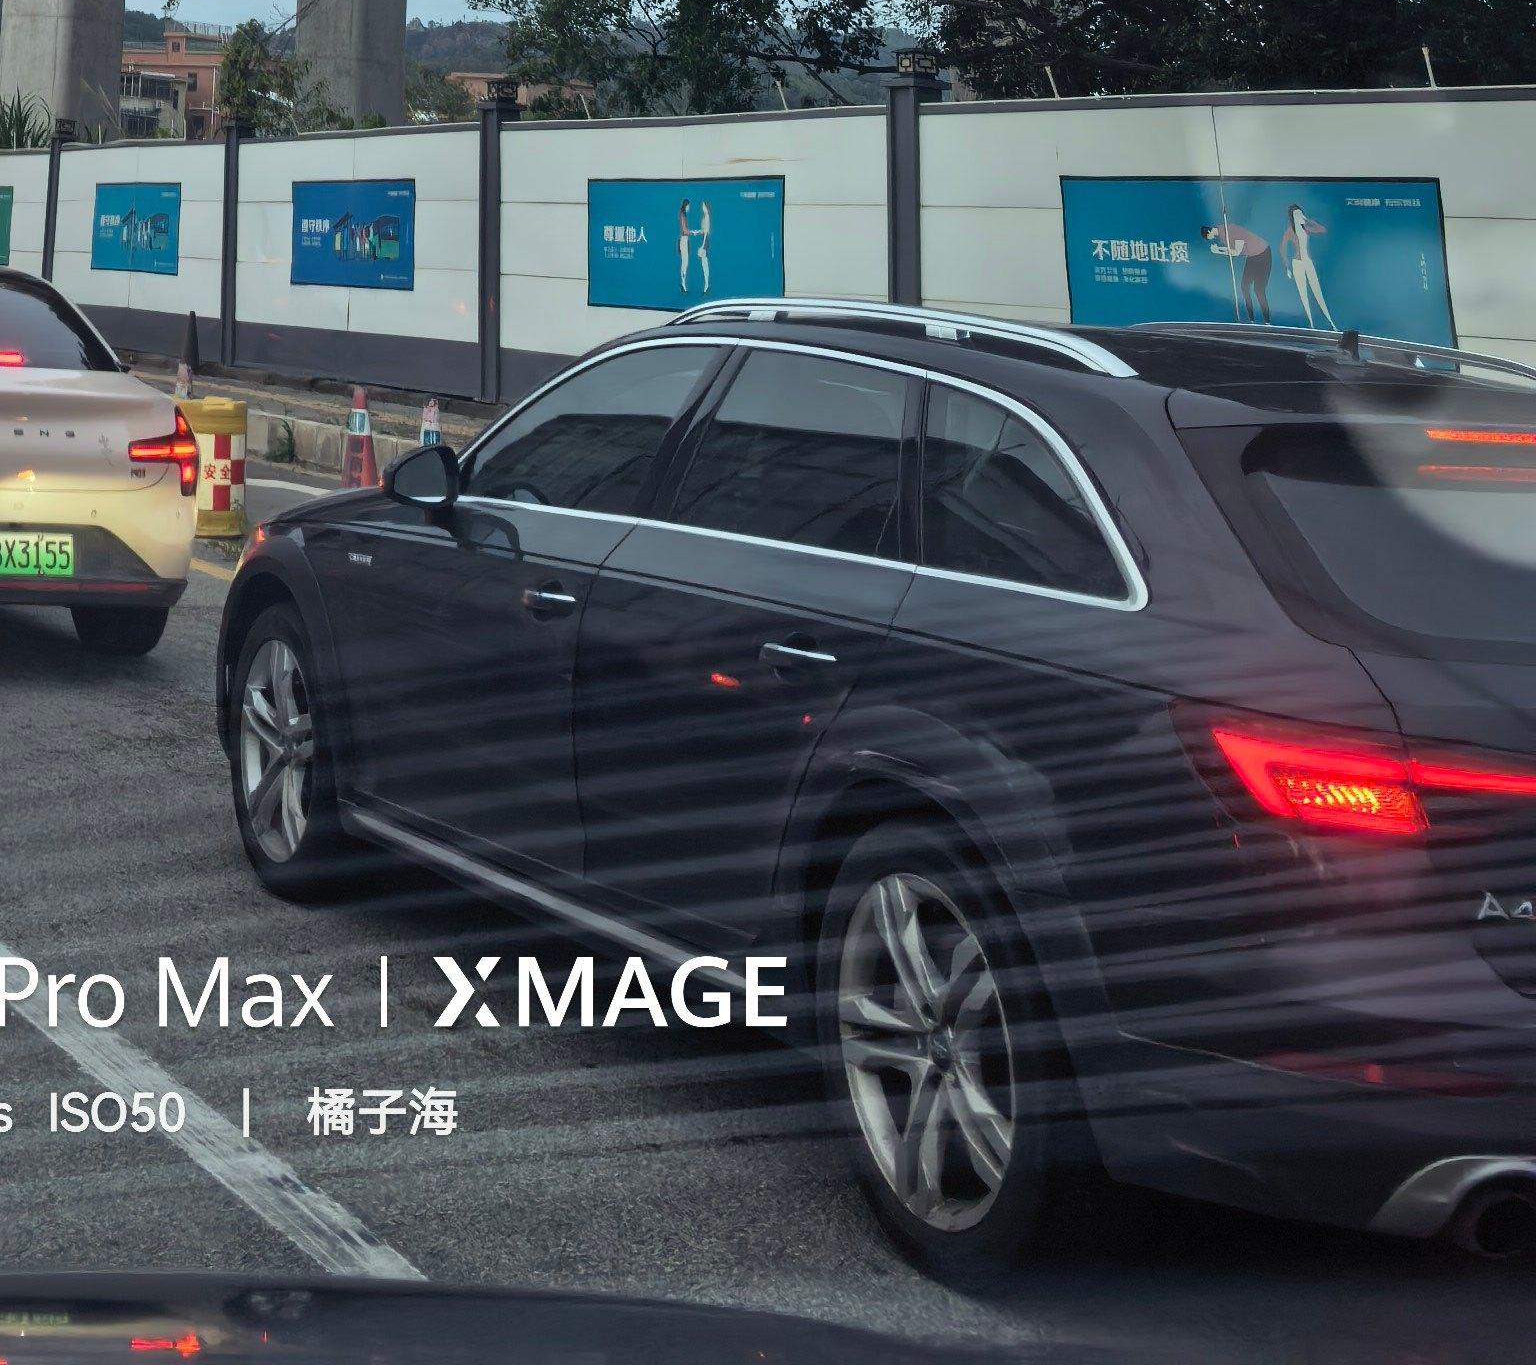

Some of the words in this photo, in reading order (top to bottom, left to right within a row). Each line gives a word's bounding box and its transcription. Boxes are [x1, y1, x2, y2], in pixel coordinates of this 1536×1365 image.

[1091, 239, 1191, 264] 不随地吐痰
[204, 463, 230, 480] 安全
